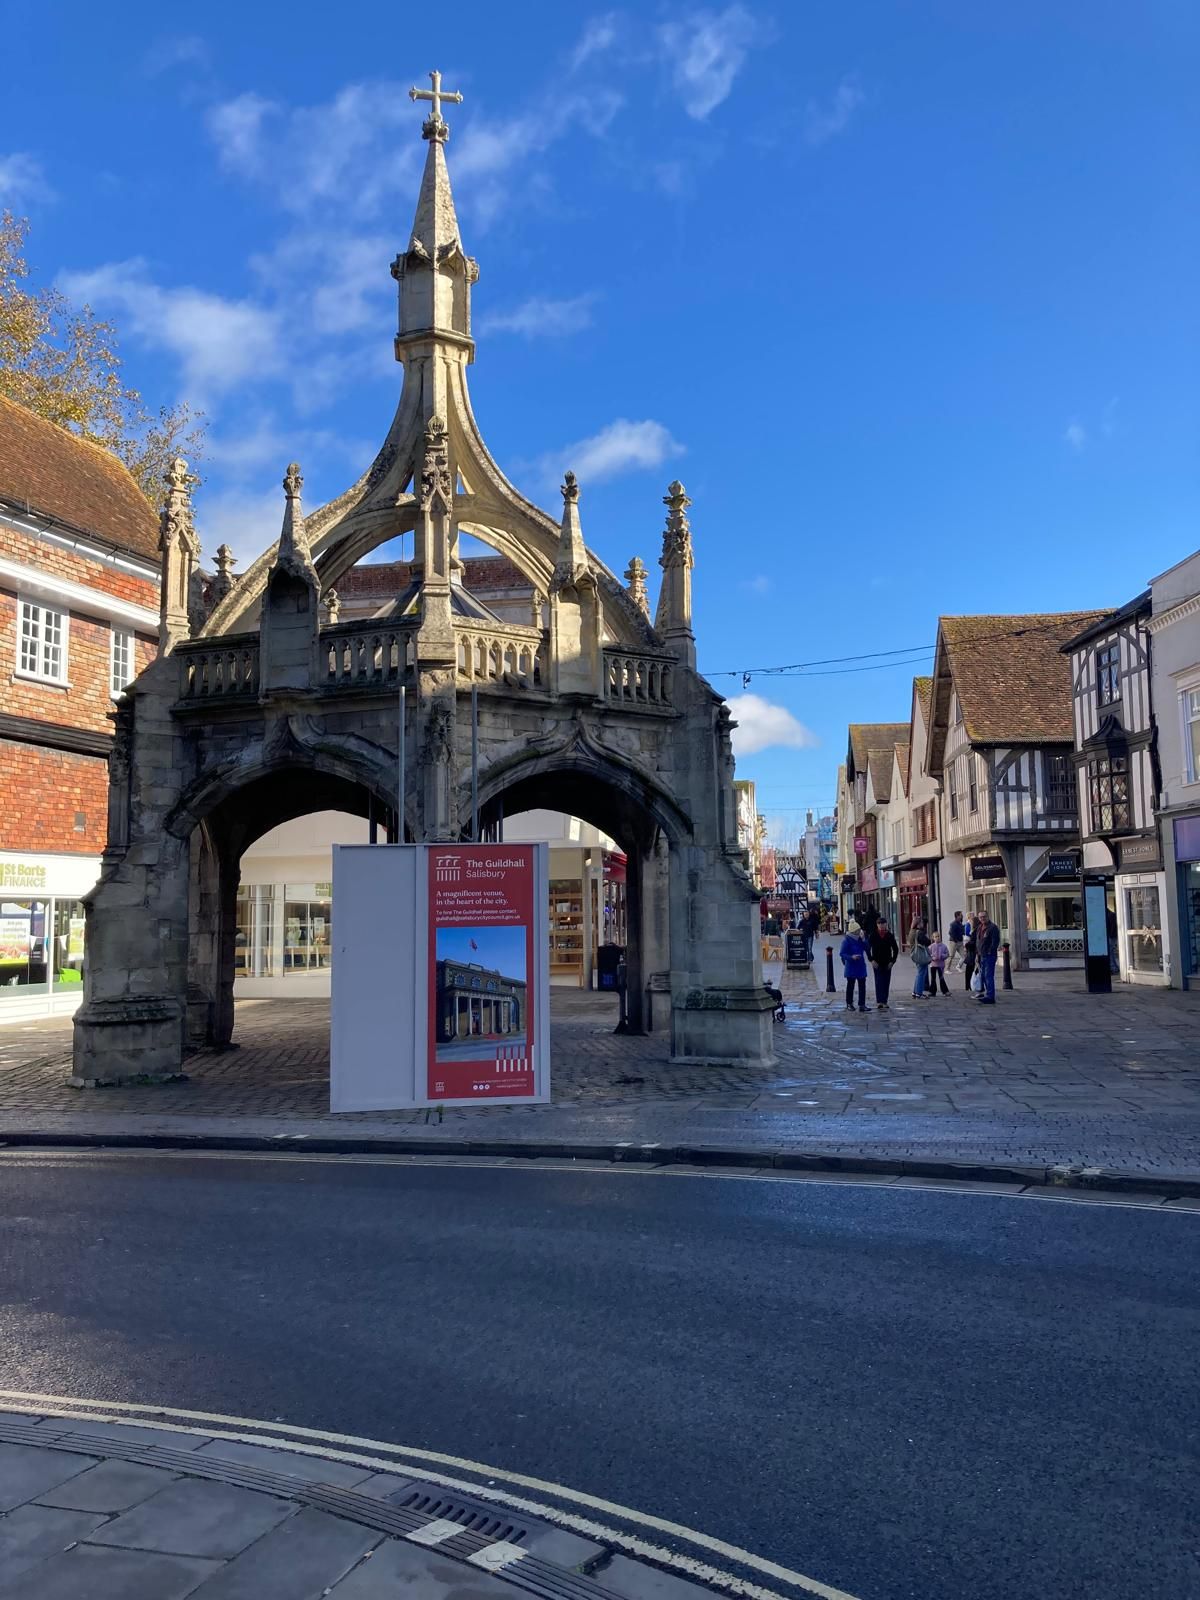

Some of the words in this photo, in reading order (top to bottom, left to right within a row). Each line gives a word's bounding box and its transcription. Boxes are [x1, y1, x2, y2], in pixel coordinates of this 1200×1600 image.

[466, 859, 483, 868] The
[485, 859, 525, 868] Guildhall
[4, 863, 17, 876] St
[17, 863, 47, 876] Barts
[465, 869, 506, 879] Salisbury
[4, 876, 47, 888] FINANCE
[442, 890, 482, 898] magnificent
[475, 897, 482, 905] of
[483, 897, 494, 905] the
[495, 897, 509, 906] city.
